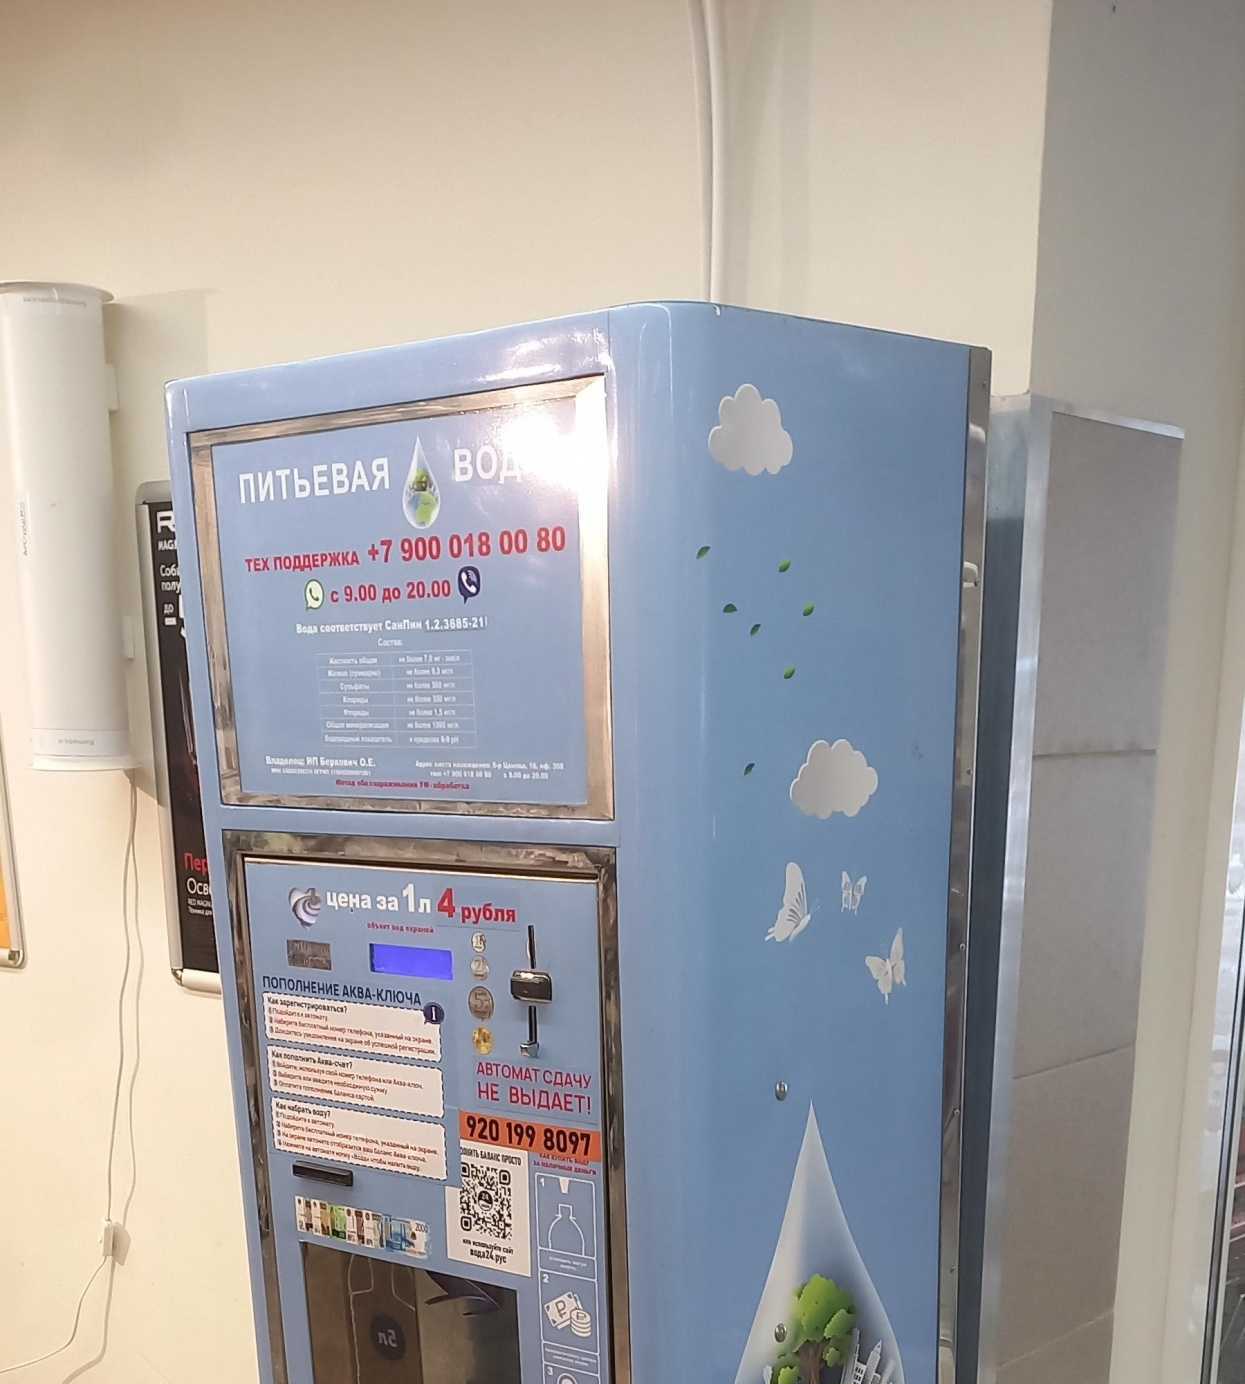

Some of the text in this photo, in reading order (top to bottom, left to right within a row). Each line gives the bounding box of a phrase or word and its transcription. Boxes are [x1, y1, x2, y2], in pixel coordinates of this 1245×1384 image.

[239, 443, 524, 504] ПИТЬЕВАЯ ВОД
[158, 540, 177, 550] MAG
[245, 526, 566, 572] ТЕХ ПОДДЕРЖКА +7 900 018 00 80
[160, 564, 180, 577] Соб
[330, 580, 451, 604] с 9.00 до 20.00
[296, 623, 318, 634] Вода
[320, 622, 383, 634] соответствует
[326, 891, 371, 910] цена
[376, 894, 399, 911] за
[437, 887, 456, 918] 4
[461, 902, 516, 924] рубля
[262, 975, 421, 1006] ПОПОЛНЕНИЕ АКВА-КЛЮЧА
[267, 996, 347, 1014] Как зарегистрироваться?
[271, 1050, 283, 1059] Как
[283, 1052, 316, 1064] пополнить
[477, 1062, 592, 1089] АВТОМАТ СДАЧУ
[275, 1101, 331, 1119] Как набрать воду?
[478, 1081, 591, 1115] НЕ ВЫДАЕТ!
[466, 1115, 591, 1156] 920 199 8097
[480, 1151, 501, 1162] БАЛАНС
[501, 1154, 522, 1166] ПРОСТО
